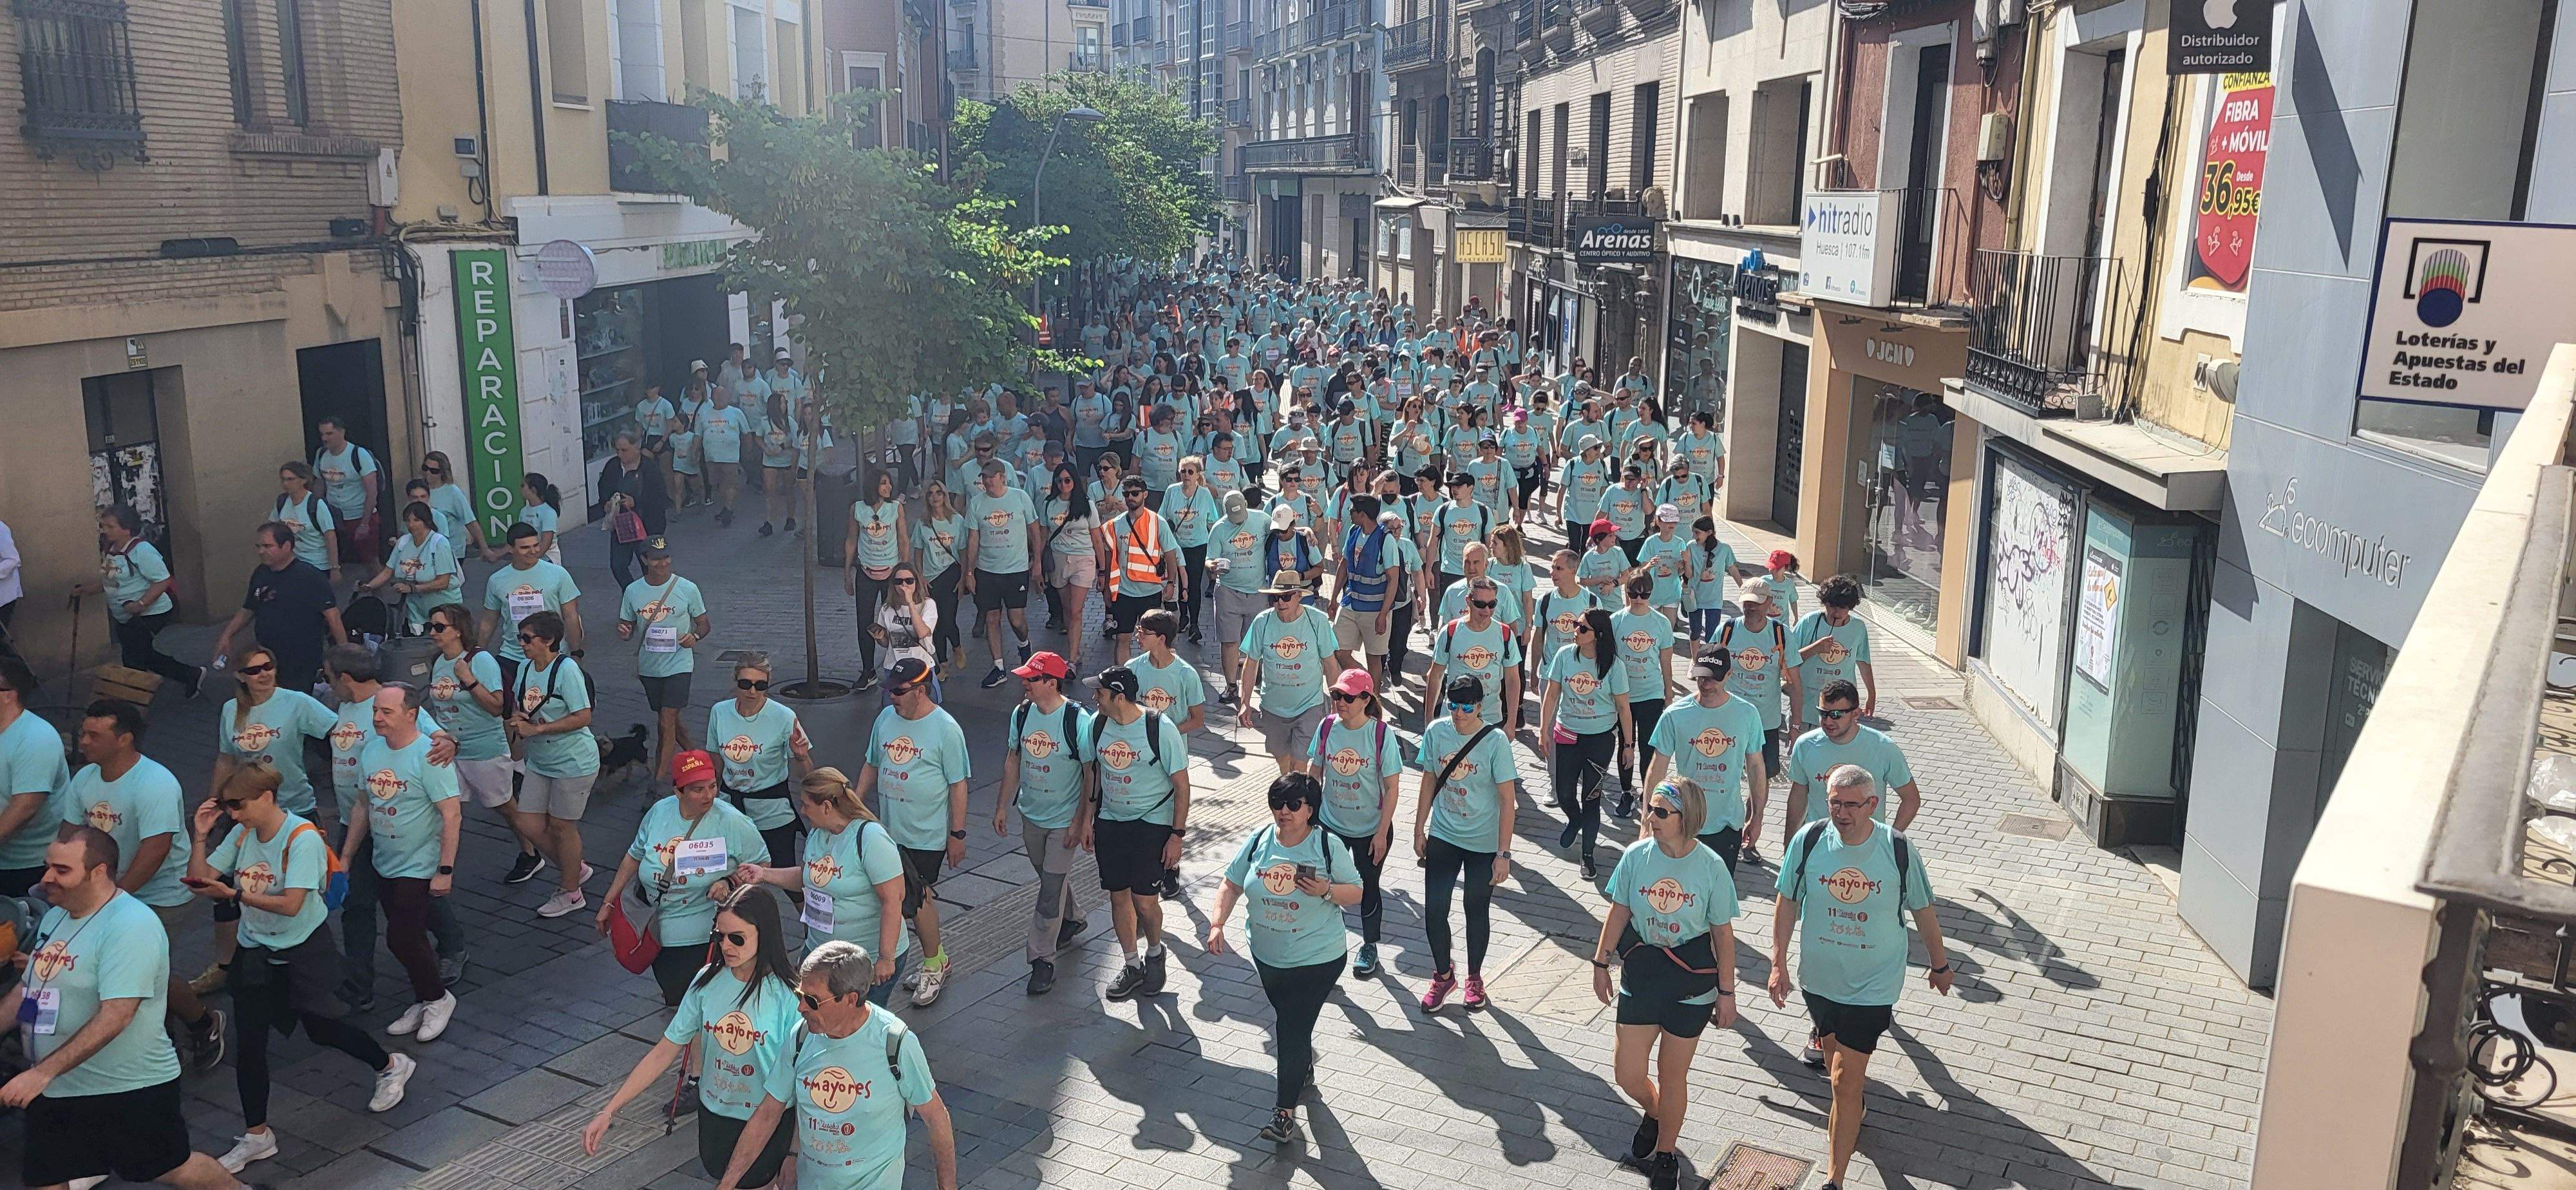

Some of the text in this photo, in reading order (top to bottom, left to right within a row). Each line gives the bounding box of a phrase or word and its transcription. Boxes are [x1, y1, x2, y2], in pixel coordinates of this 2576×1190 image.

[2181, 33, 2260, 47] Distribuidor
[2183, 52, 2253, 65] autorizado
[2223, 71, 2270, 90] CONFIANZA
[2224, 99, 2259, 124] FIBRA
[2228, 126, 2268, 153] MÓVIL
[2236, 171, 2253, 182] Desde
[1819, 202, 1873, 236] hitradio
[1459, 232, 1502, 256] ASCASO
[1580, 230, 1651, 249] Arenas
[1816, 240, 1870, 260] Huesca 107.1fm
[2396, 331, 2497, 355] Loterías y
[2393, 351, 2526, 375] Apuestas del
[2389, 371, 2458, 390] Estado
[470, 261, 513, 538] REPARACION
[1673, 493, 1699, 504] +mayores
[983, 513, 1014, 524] +mayores
[1448, 523, 1478, 533] +mayores
[1228, 534, 1258, 546] +mayores
[2291, 511, 2412, 590] ecomputer
[1269, 641, 1308, 652] +mayores
[1620, 635, 1656, 649] +mayores
[1456, 650, 1499, 663] +mayores
[1698, 656, 1723, 666] adidas
[1732, 650, 1773, 665] +mayores
[1564, 675, 1603, 690] +mayores
[1139, 691, 1177, 705] +mayores
[719, 742, 763, 757] +mayores
[882, 740, 923, 762] +mayores
[1021, 735, 1061, 753] +mayores
[1688, 735, 1736, 755] +mayores
[1098, 747, 1141, 763] +mayores
[1326, 754, 1370, 770] +mayores
[681, 760, 705, 773] ESPAÑA
[1437, 756, 1478, 775] +myores
[365, 777, 408, 794] +mayores
[688, 841, 714, 850] 06035
[1819, 874, 1882, 895] +mayores
[1639, 886, 1696, 909] +mayores
[1828, 907, 1836, 917] 11
[1647, 916, 1655, 927] 11
[704, 1021, 768, 1046] +mayores
[803, 1077, 872, 1102] +mayores
[808, 1117, 818, 1131] 11
